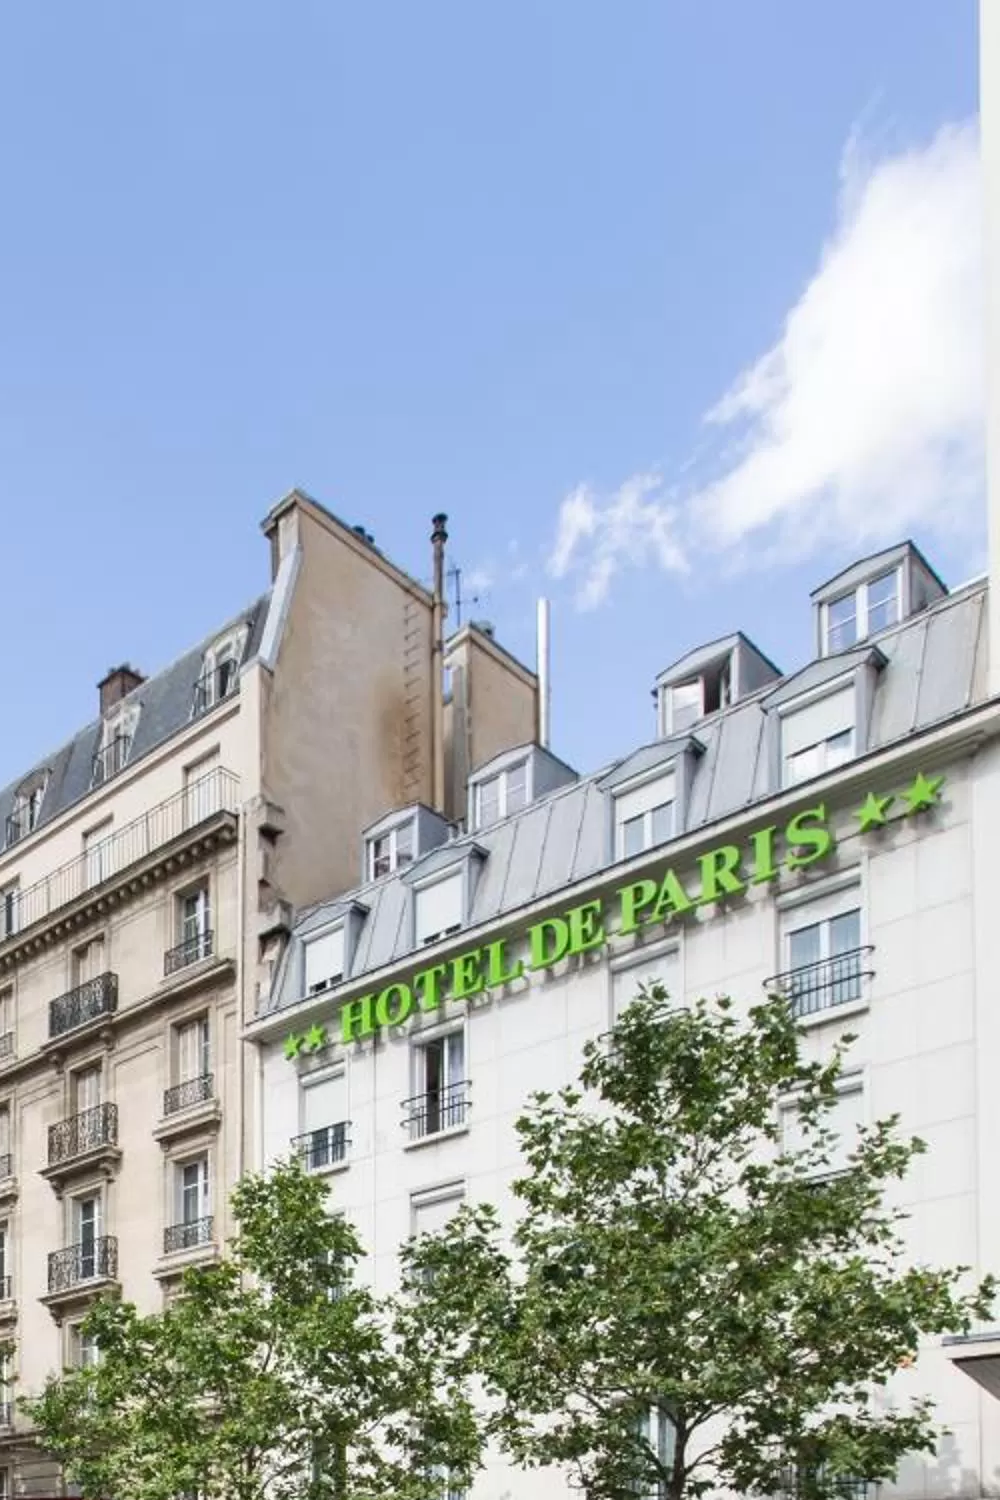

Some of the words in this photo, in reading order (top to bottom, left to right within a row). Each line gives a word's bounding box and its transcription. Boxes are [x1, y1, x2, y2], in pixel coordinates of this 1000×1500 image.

[339, 939, 524, 1043] HOTEL
[526, 899, 605, 971] DE
[616, 801, 834, 937] PARIS
